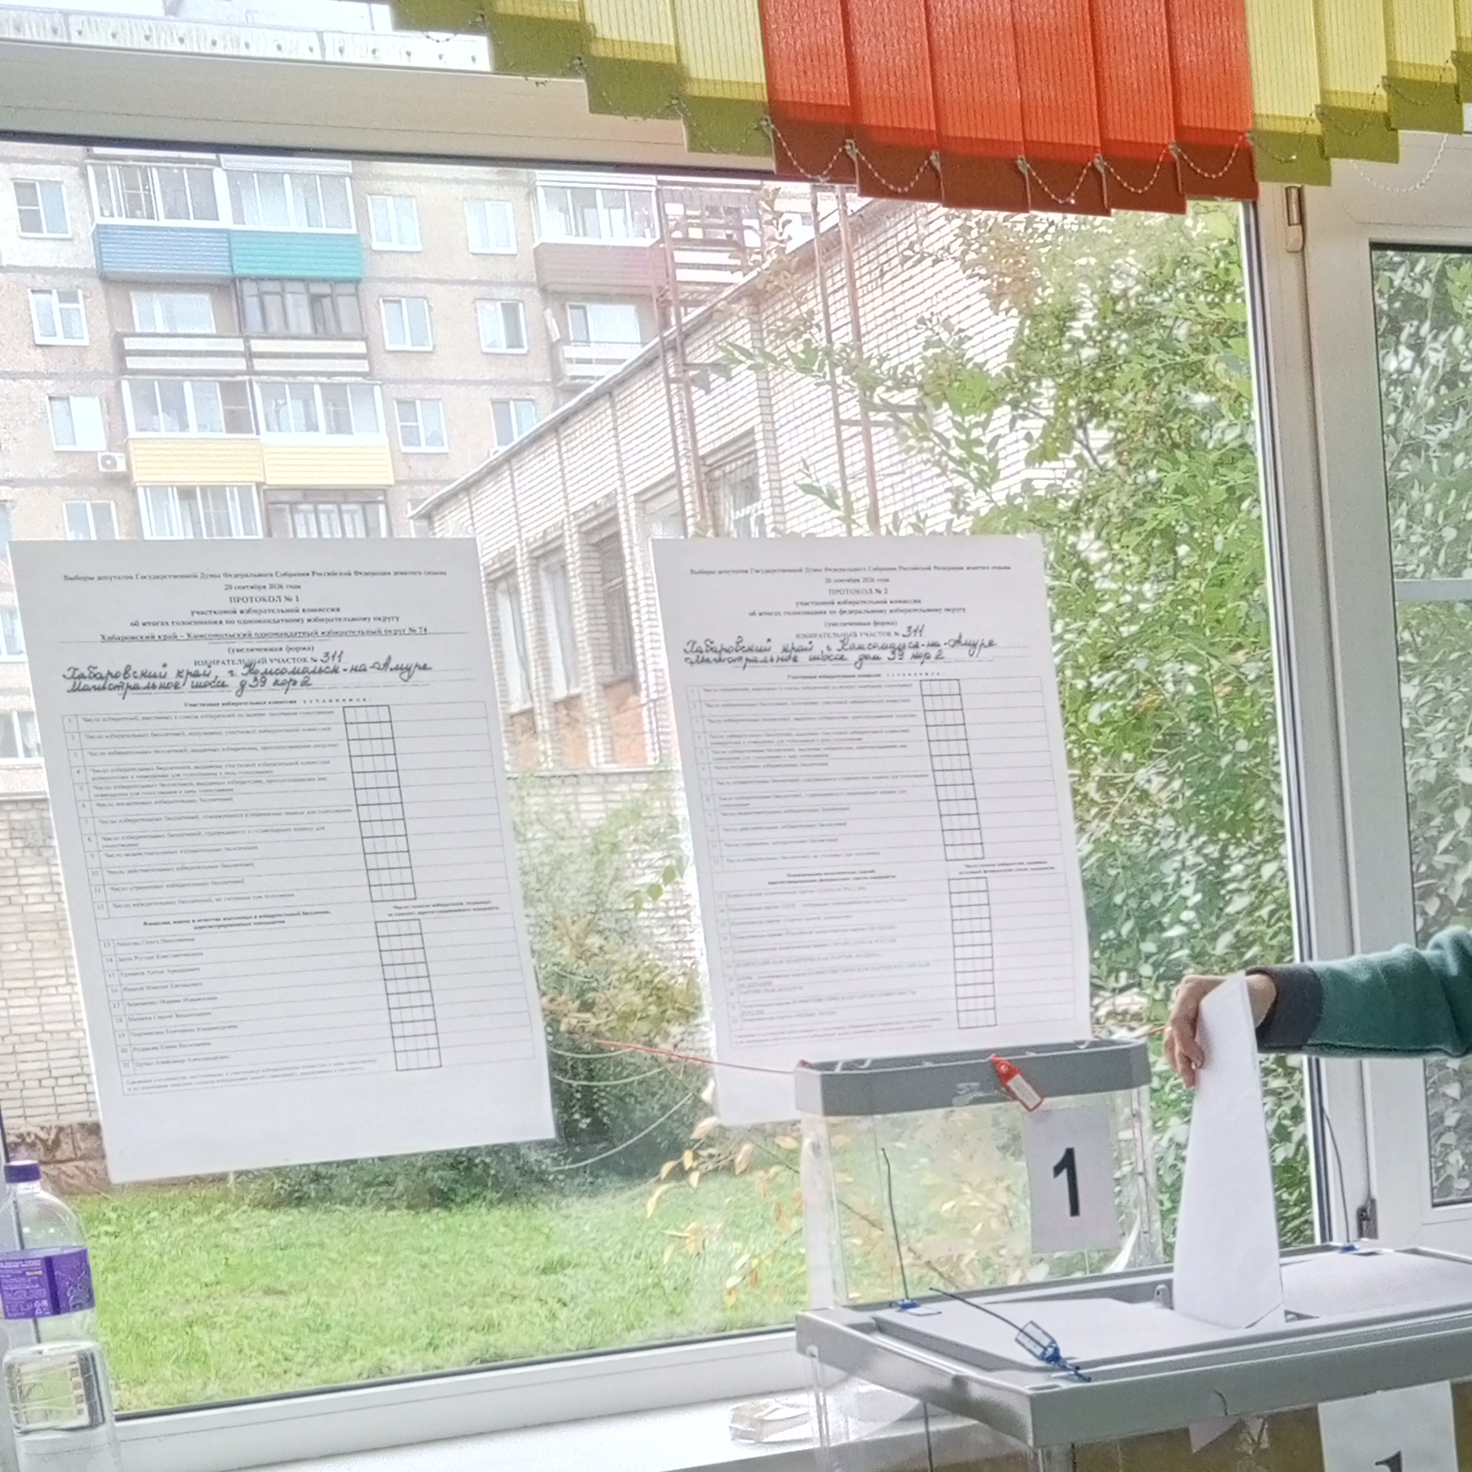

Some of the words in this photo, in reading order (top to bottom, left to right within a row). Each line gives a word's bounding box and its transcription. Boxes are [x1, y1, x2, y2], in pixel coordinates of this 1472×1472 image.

[229, 595, 282, 603] ПРОТОКОЛ
[902, 624, 925, 638] 311
[320, 650, 344, 663] 311
[1052, 1147, 1080, 1217] 1
